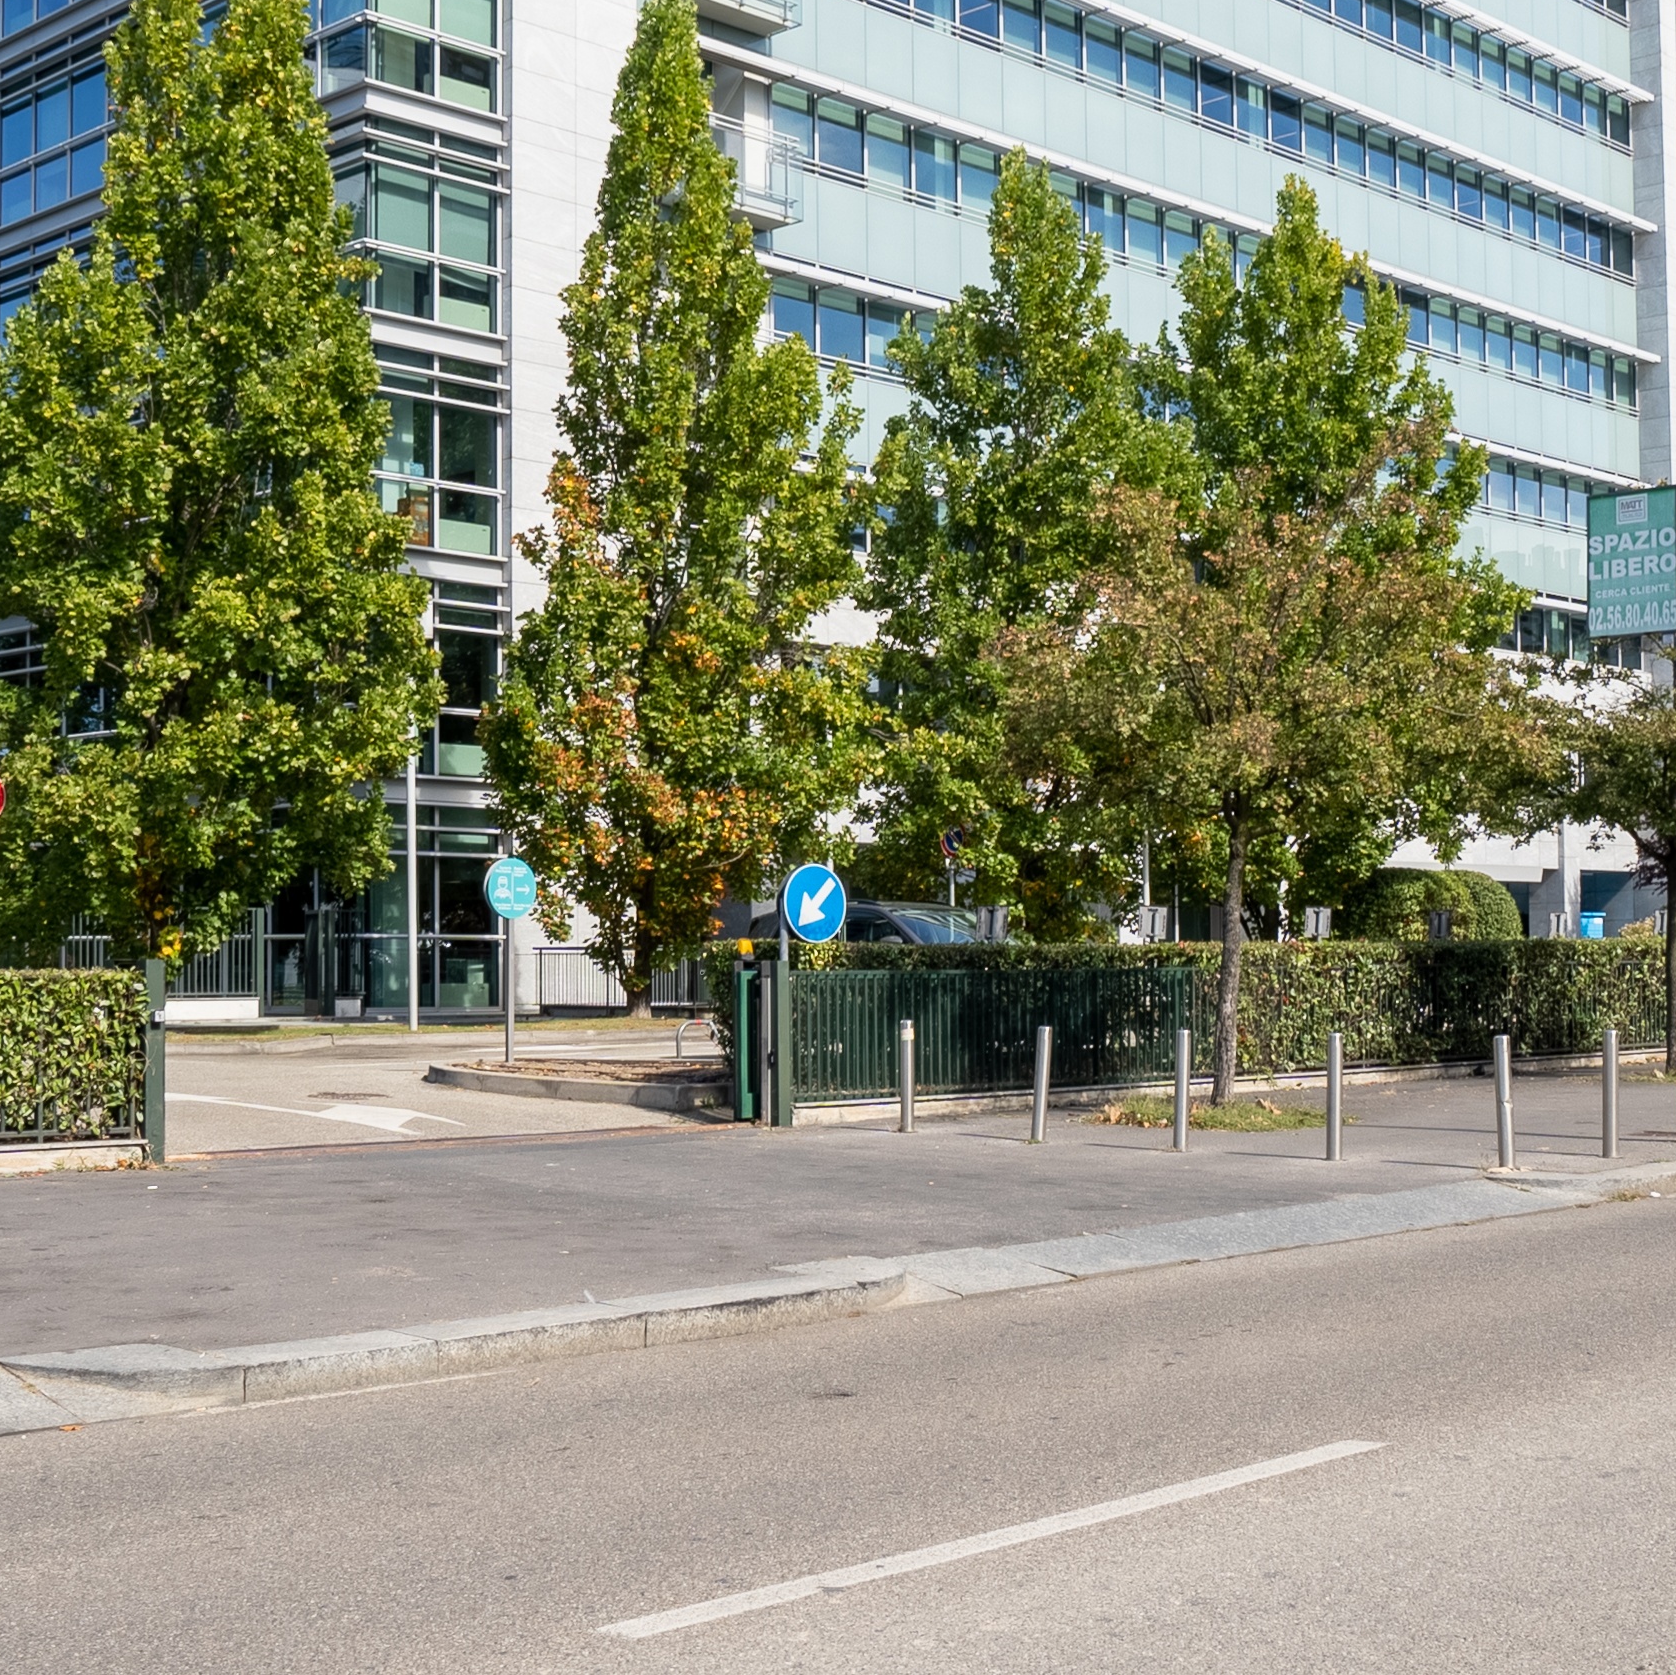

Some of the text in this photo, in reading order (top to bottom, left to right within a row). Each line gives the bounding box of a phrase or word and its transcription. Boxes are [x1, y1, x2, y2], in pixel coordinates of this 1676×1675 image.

[1588, 527, 1676, 556] SPAZIO
[1595, 583, 1671, 599] CERCA CLIENTE
